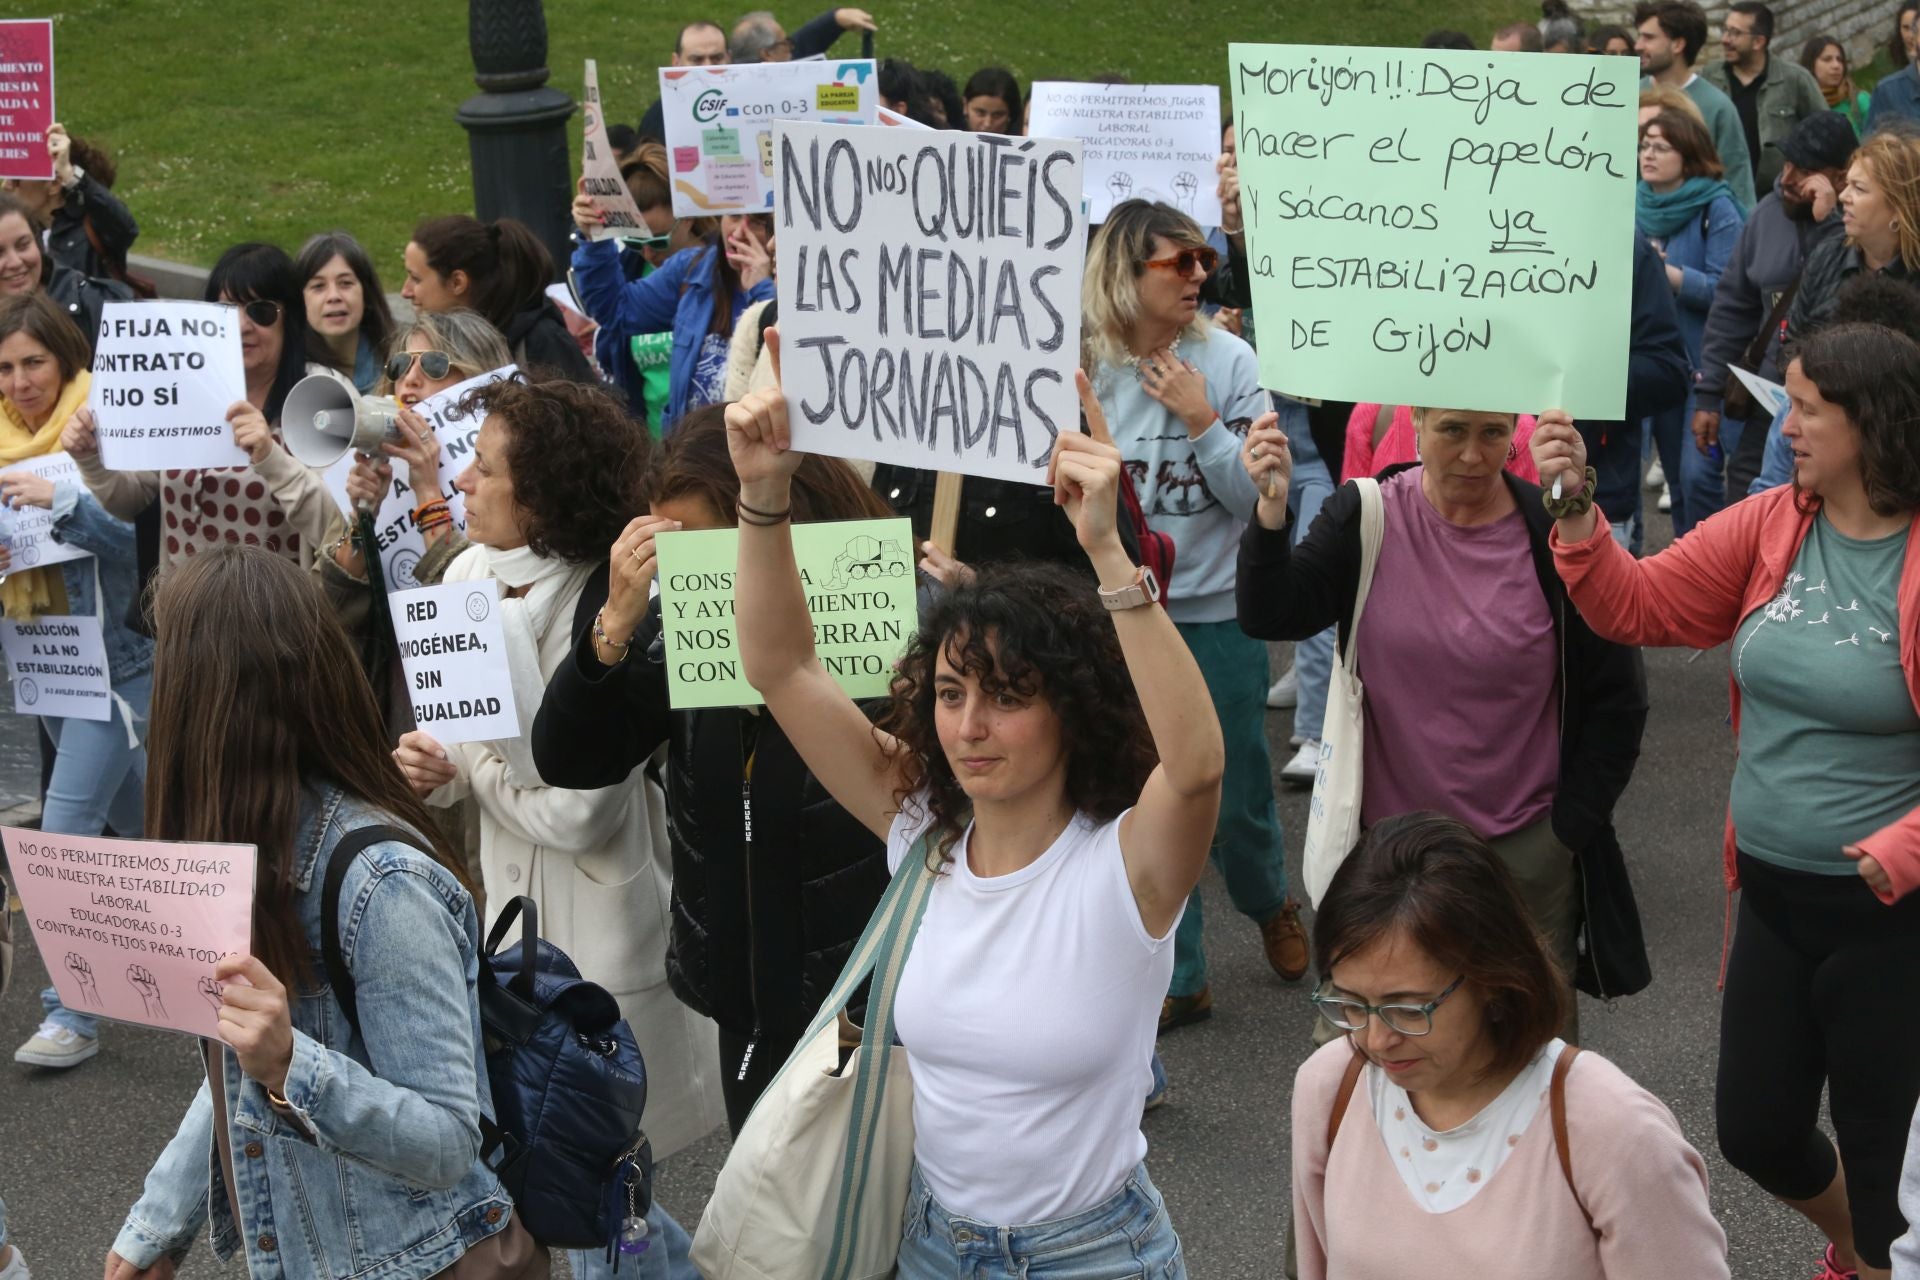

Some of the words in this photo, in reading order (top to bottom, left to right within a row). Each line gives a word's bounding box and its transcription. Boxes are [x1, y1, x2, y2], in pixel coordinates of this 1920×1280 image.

[20, 82, 40, 92] DA
[1416, 62, 1537, 125] Deja
[1561, 67, 1626, 107] de
[743, 104, 775, 115] con
[781, 100, 808, 113] 0-3
[1063, 95, 1078, 104] OS
[1081, 95, 1167, 106] PERMITIREMOS
[1168, 96, 1206, 106] JUGAR
[1047, 108, 1071, 118] CON
[1072, 109, 1124, 119] NUESTRA
[1127, 110, 1204, 120] ESTABILIDAD
[27, 132, 44, 142] DE
[1098, 123, 1151, 132] LABORAL
[1076, 136, 1151, 147] DUCADORAS
[1241, 110, 1354, 159] hacer
[1369, 128, 1420, 163] el
[1444, 127, 1627, 194] papelón
[1107, 151, 1138, 161] FIJOS
[1142, 151, 1172, 160] PARA
[1176, 152, 1213, 162] TODAS
[782, 133, 862, 233] NO
[866, 153, 908, 196] NOS
[1489, 209, 1547, 250] ya
[796, 244, 861, 313] LAS
[878, 241, 1064, 353] MEDIAS
[115, 318, 172, 338] FIJA
[181, 318, 225, 338] NO:
[1292, 319, 1332, 350] DE
[103, 388, 144, 407] FIJO
[154, 382, 178, 405] SÍ
[795, 335, 1062, 469] JORNADAS
[109, 425, 144, 438] AVILÉS
[149, 425, 222, 438] EXISTIMOS
[406, 600, 437, 623] RED
[672, 602, 687, 619] Y
[16, 622, 80, 636] SOLUCIÓN
[676, 628, 731, 650] NOS
[33, 644, 41, 655] A
[43, 644, 59, 655] LA
[61, 645, 79, 656] NO
[16, 662, 102, 676] ESTABILIZACIÓN
[679, 661, 736, 683] CON
[416, 670, 442, 690] SIN
[414, 697, 501, 723] GUALDAD
[19, 841, 37, 855] NO
[41, 846, 57, 860] OS
[61, 849, 169, 872] PERMITIREMOS
[172, 858, 231, 875] JUGAR
[28, 863, 53, 878] CON
[58, 867, 115, 888] NUESTRA
[120, 877, 225, 897] ESTABILIDAD
[91, 892, 151, 913] LABORAL
[70, 907, 157, 935] EDUCADORAS
[160, 924, 182, 938] 0-3
[36, 919, 108, 944] CONTRATOS
[111, 933, 147, 951] FIJOS
[149, 942, 185, 958] PARA
